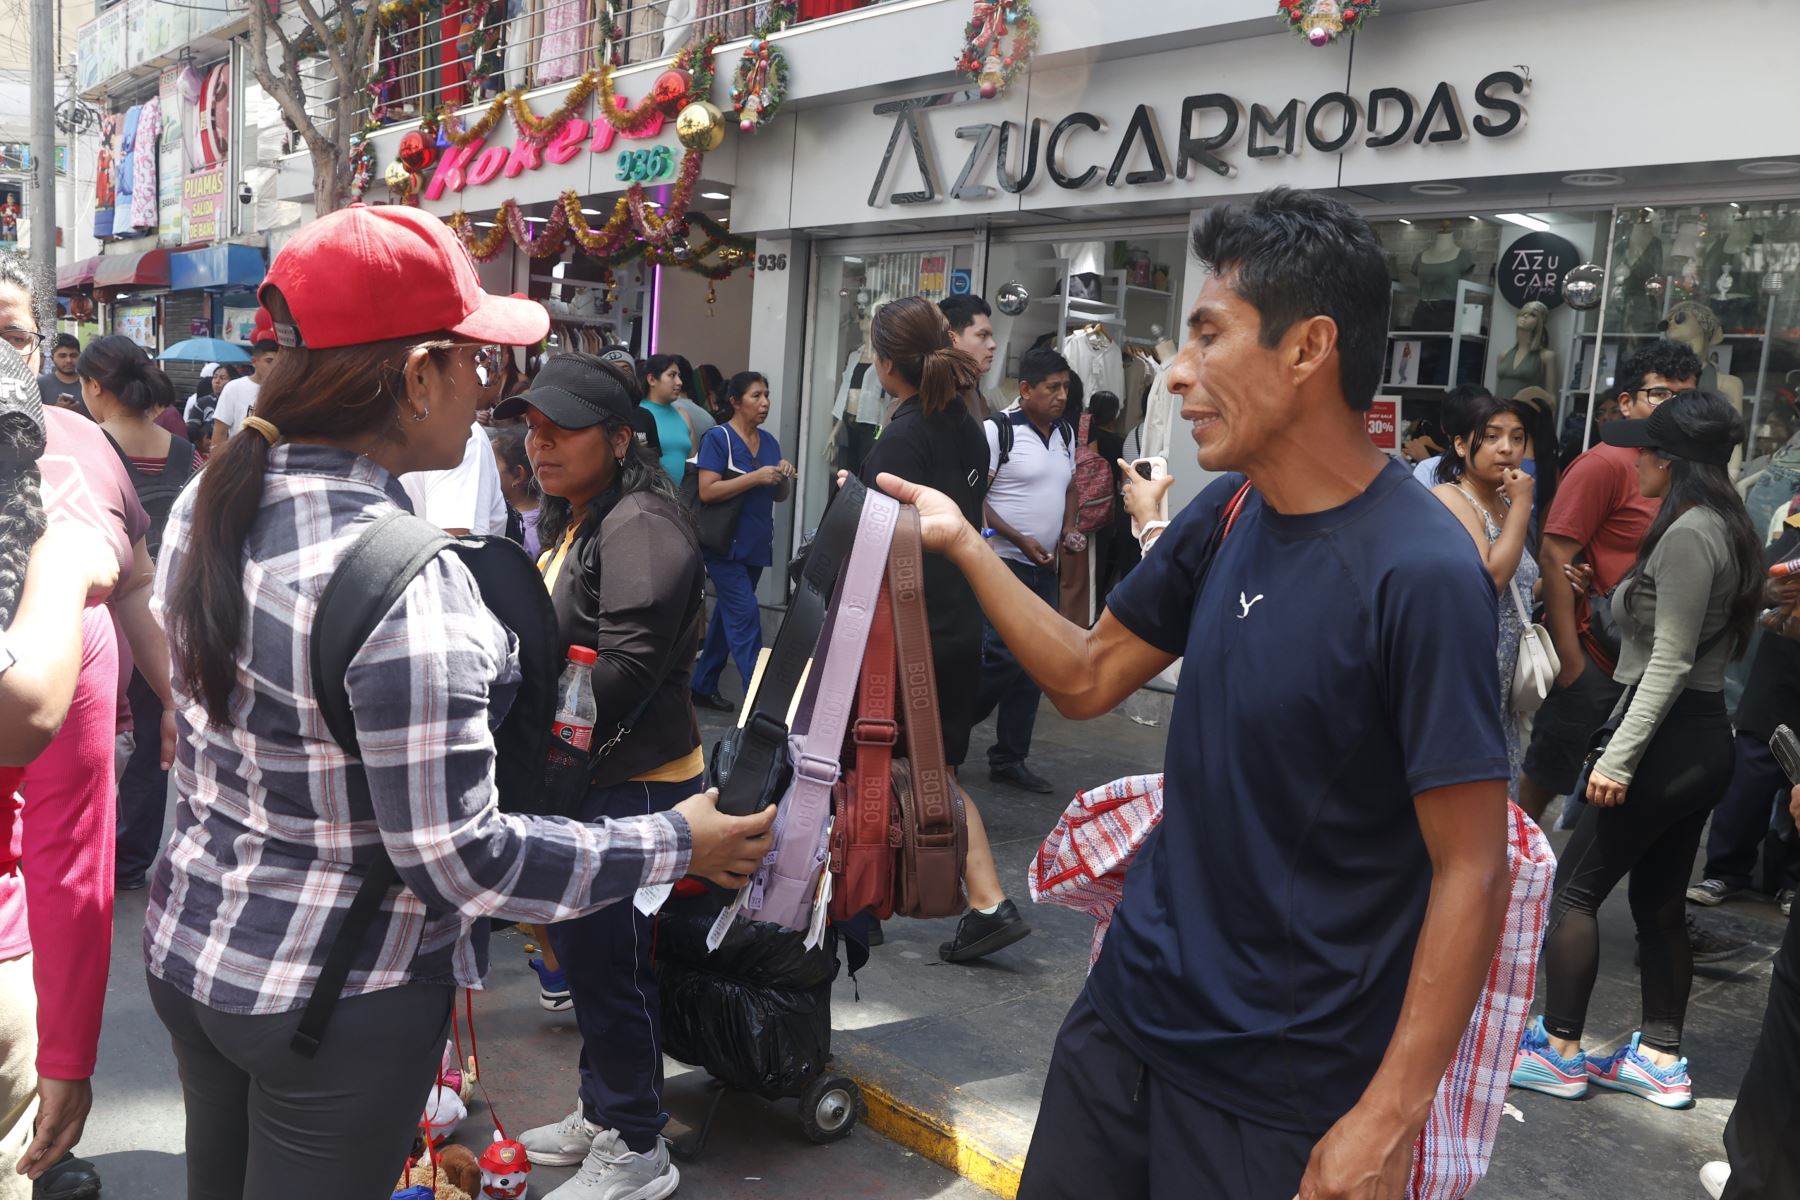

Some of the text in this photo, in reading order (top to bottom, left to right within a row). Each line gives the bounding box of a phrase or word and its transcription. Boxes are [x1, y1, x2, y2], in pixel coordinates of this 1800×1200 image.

[616, 144, 670, 182] 936
[184, 172, 224, 199] PIJAMAS
[191, 200, 214, 217] SALIDA
[757, 253, 786, 271] 936
[1511, 249, 1559, 270] AZU
[1513, 272, 1557, 287] CAR
[1368, 420, 1394, 434] 30%
[897, 556, 916, 602] BOBO
[868, 674, 886, 718] BOBO
[907, 662, 930, 710] BOBO
[863, 776, 883, 823] BOBO
[921, 769, 944, 817] BOBO
